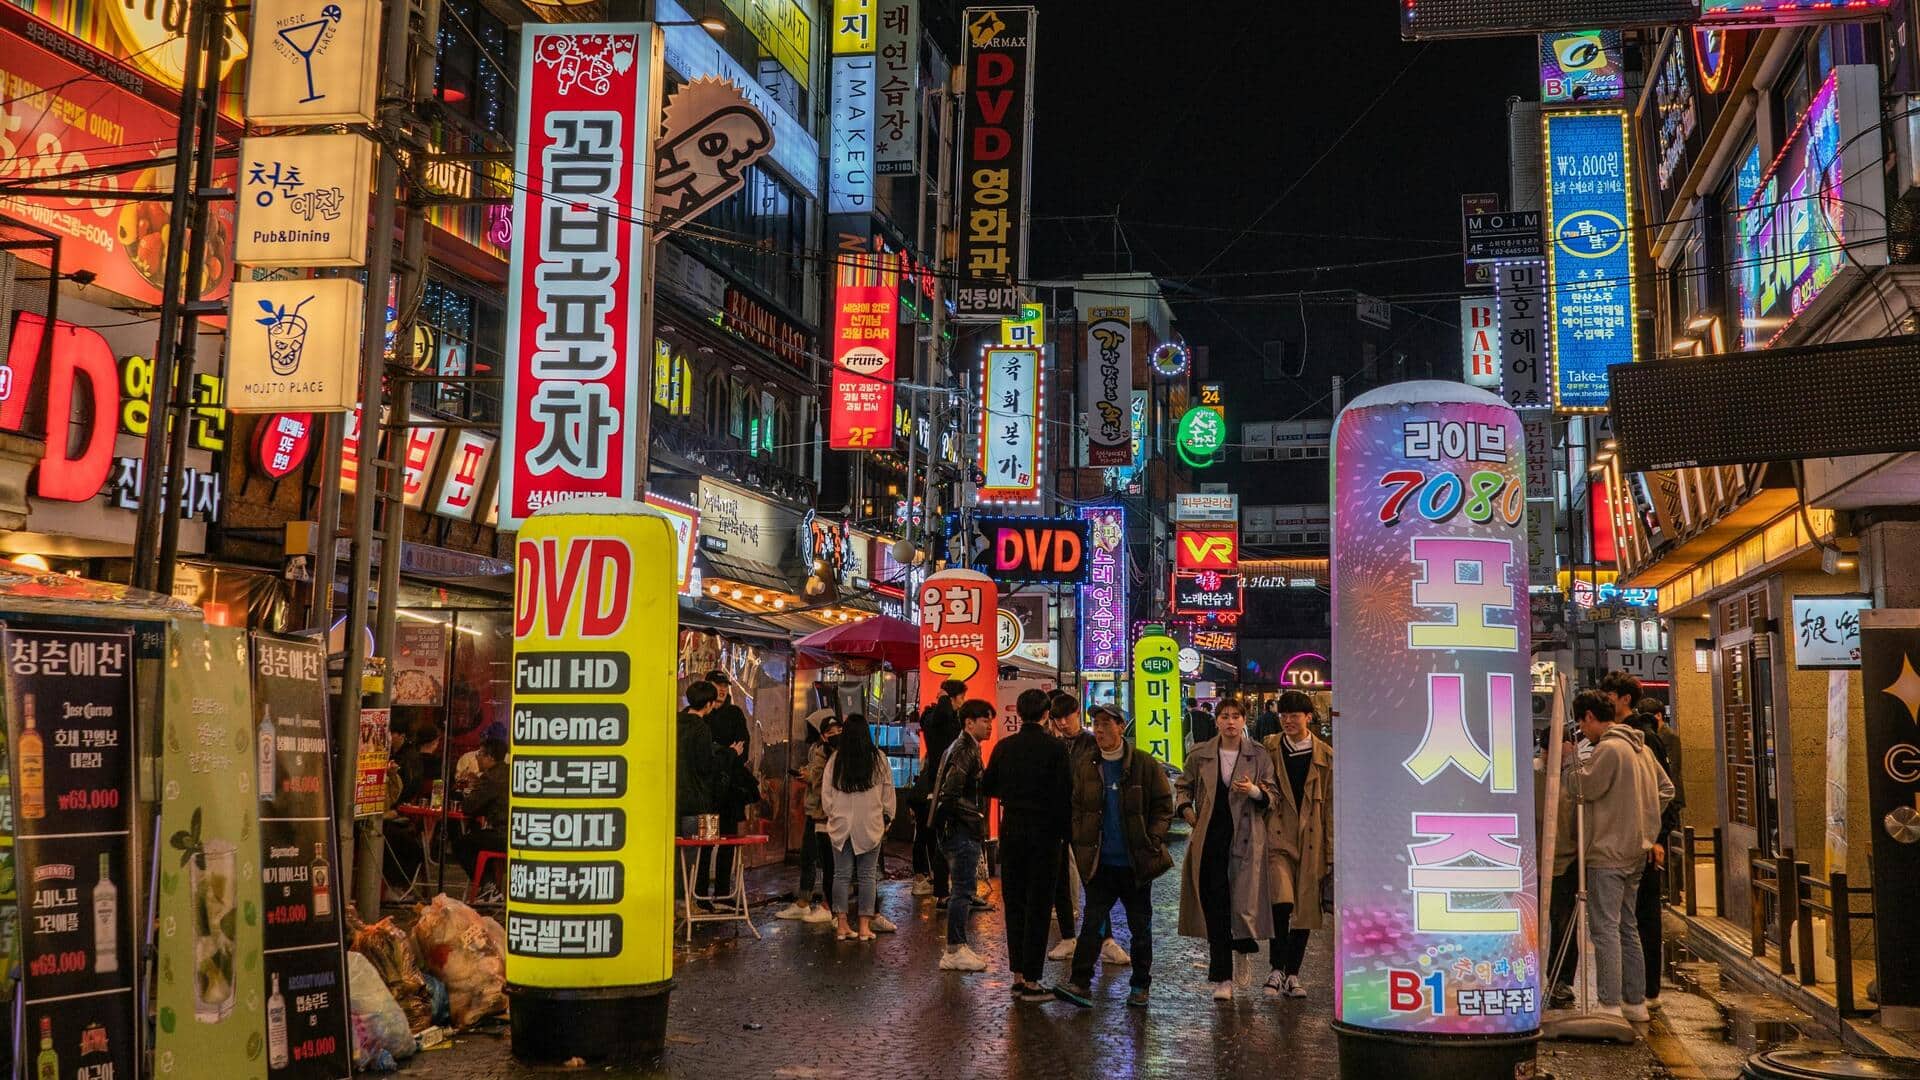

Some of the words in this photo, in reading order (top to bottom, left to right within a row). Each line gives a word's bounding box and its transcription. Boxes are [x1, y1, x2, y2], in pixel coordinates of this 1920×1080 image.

[277, 14, 305, 27] MUSIC
[841, 0, 868, 39] 지
[272, 39, 299, 64] MOJITO
[316, 27, 337, 55] PLACE
[847, 61, 872, 70] J
[1546, 77, 1574, 97] B1
[974, 53, 1015, 160] DVD
[846, 79, 867, 206] MAKEUP
[1557, 151, 1619, 180] ₩3,800원
[248, 162, 304, 207] 청춘
[290, 187, 344, 222] 예찬
[253, 230, 330, 243] Pub&Dining
[968, 168, 1011, 279] 영화관
[526, 110, 623, 480] 꼼보포차
[958, 288, 1017, 311] 진동의자
[864, 328, 890, 340] BAR
[1471, 305, 1493, 376] BAR
[1508, 267, 1538, 384] 민호헤어
[846, 357, 884, 366] Fruits
[245, 382, 284, 394] MOJITO
[289, 381, 324, 393] PLACE
[1202, 391, 1220, 403] 24
[998, 357, 1023, 480] 육회본가
[848, 427, 877, 447] 2F
[1403, 420, 1508, 464] 라이브
[117, 457, 222, 523] 진의자
[527, 489, 608, 510] 성신여
[1378, 469, 1524, 527] 7080
[995, 527, 1082, 574] DVD
[1182, 536, 1233, 563] VR
[515, 536, 633, 641] DVD
[1092, 547, 1116, 651] 노래연습장
[1181, 592, 1234, 606] 노래연습장
[924, 586, 981, 633] 육회
[11, 638, 126, 678] 청춘예찬
[259, 644, 319, 681] 청춘예찬
[516, 658, 561, 689] Full
[569, 658, 620, 689] HD
[1097, 655, 1111, 666] B1
[1144, 660, 1170, 670] 넥타이
[513, 710, 621, 741] Cinema
[1147, 679, 1171, 763] 마사지
[1402, 535, 1523, 935] 포시즌
[512, 759, 618, 795] 대형스크린
[510, 811, 617, 848] 진동의자
[32, 887, 79, 908] 스미노프
[510, 864, 615, 900] 영화+팝콘+커피
[33, 912, 79, 934] 그린애플
[508, 915, 614, 954] 무료셀프바
[1452, 957, 1509, 984] 추억과
[1512, 952, 1536, 982] 낭만
[1387, 966, 1446, 1016] B1
[1456, 986, 1535, 1016] 단란주점
